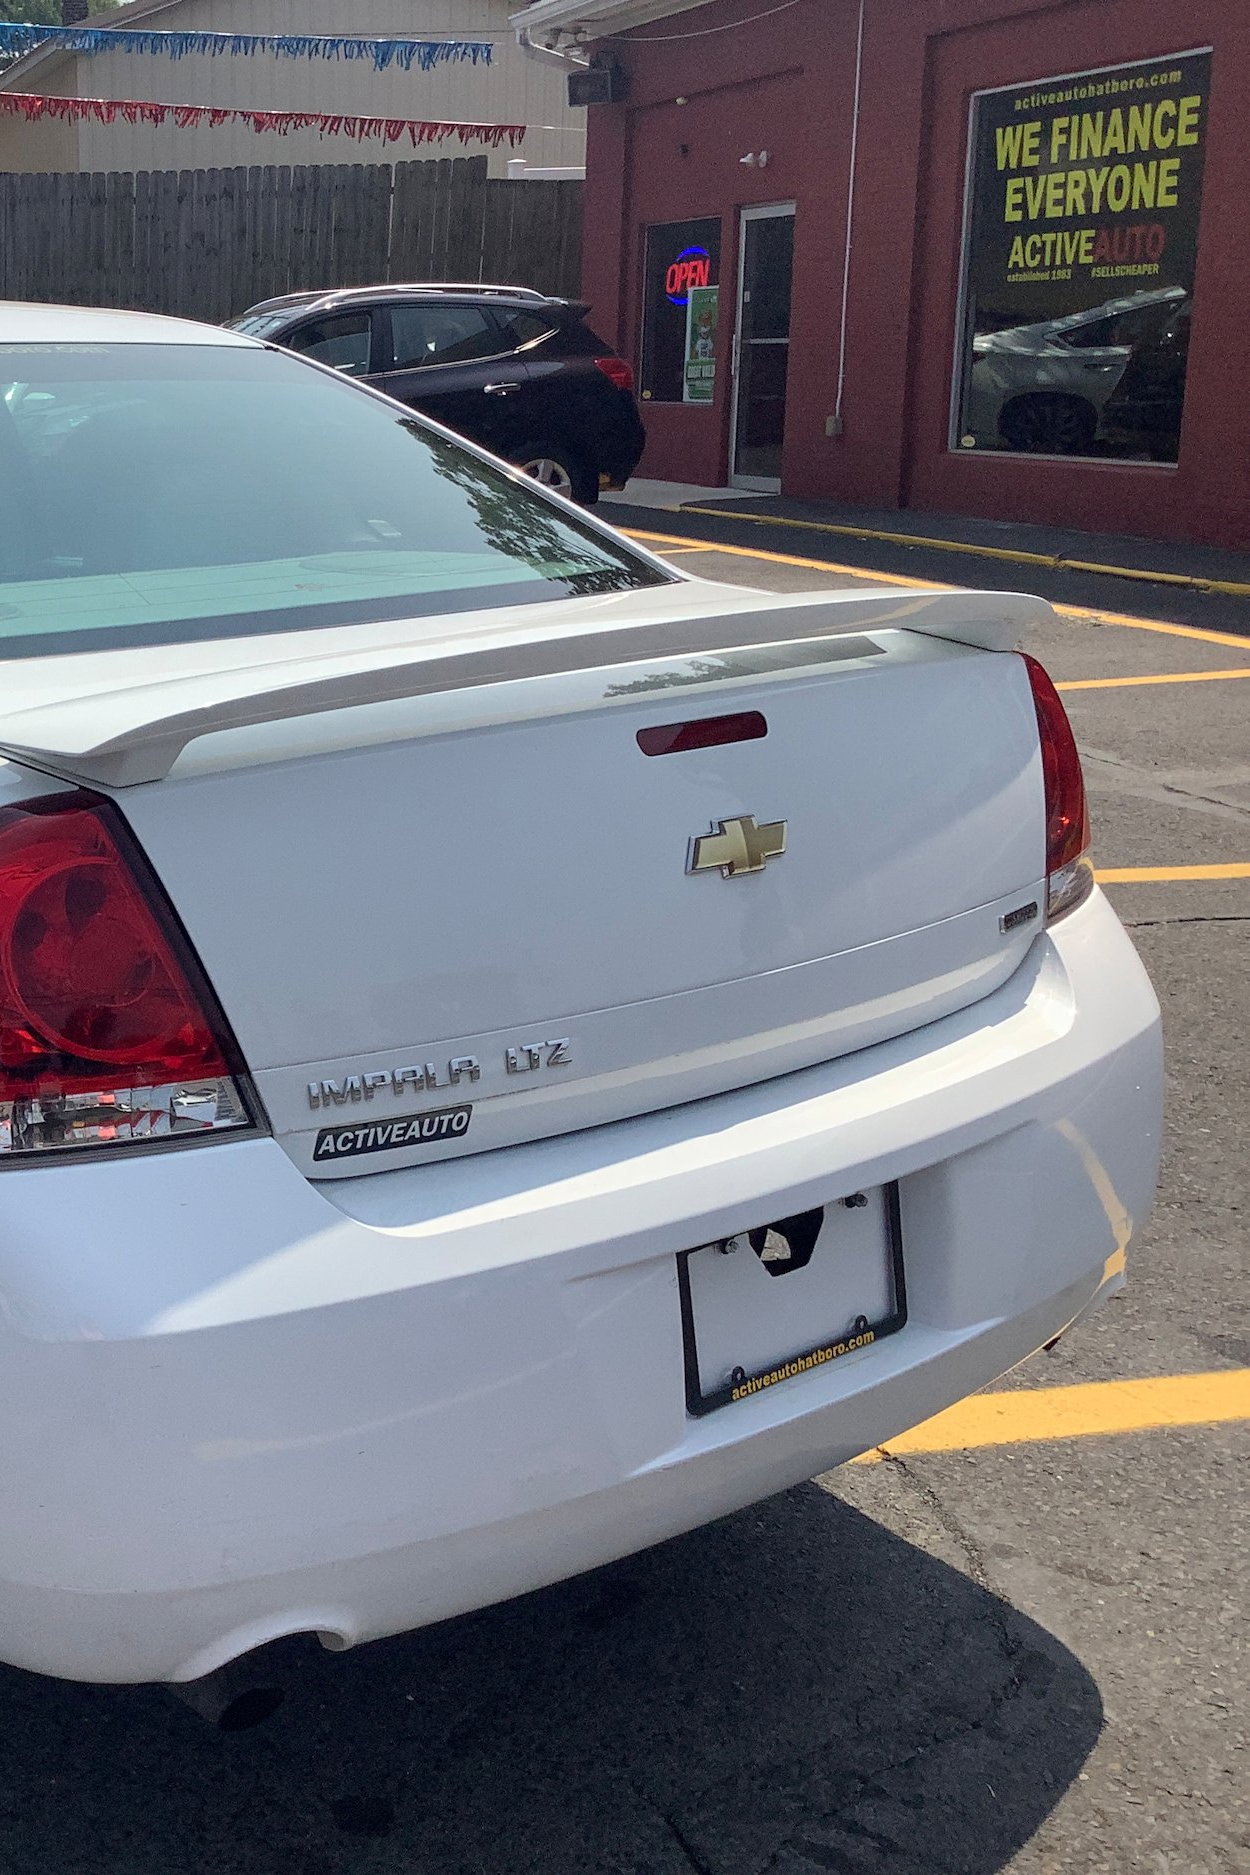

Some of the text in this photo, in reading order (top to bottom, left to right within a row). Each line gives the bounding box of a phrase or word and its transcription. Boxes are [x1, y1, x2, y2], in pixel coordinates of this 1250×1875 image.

[995, 94, 1201, 171] WE FINANCE
[1004, 157, 1181, 223] EVERYONE
[664, 259, 711, 295] OPEN
[1091, 262, 1160, 279] #SELLSCHEAPER
[307, 1036, 573, 1110] IMPALA LTZ
[317, 1110, 469, 1156] ACTIVEAUTO
[731, 1329, 875, 1401] activeautohatboro.com
